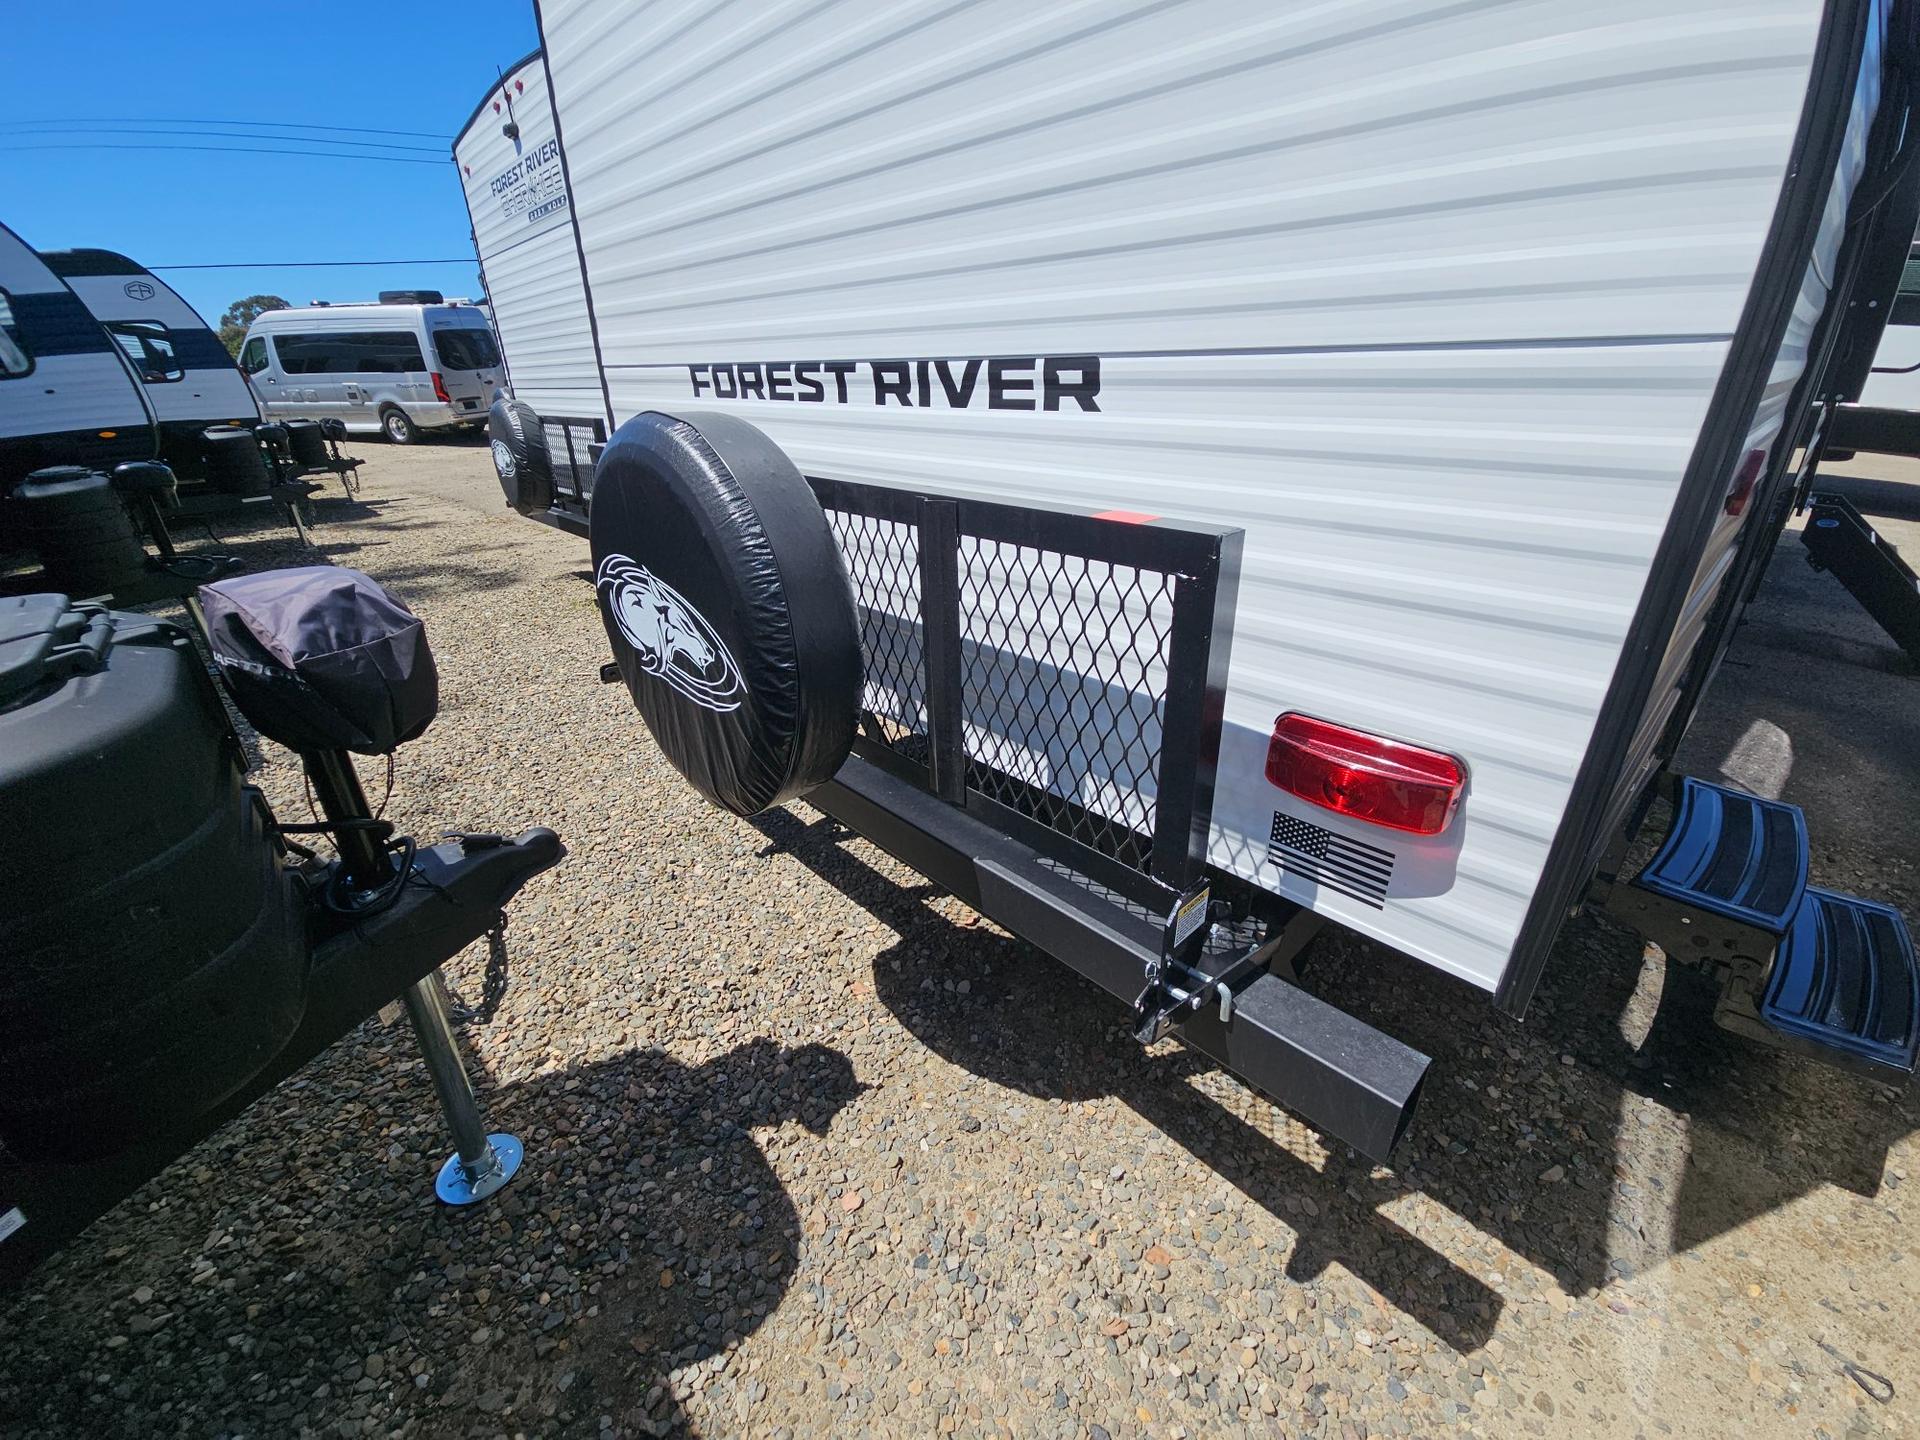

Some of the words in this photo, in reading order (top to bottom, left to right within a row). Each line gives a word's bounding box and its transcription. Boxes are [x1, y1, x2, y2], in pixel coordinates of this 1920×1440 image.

[490, 161, 523, 197] FOREST
[525, 139, 558, 174] RIVER
[688, 361, 856, 403] FOREST
[869, 355, 1101, 412] RIVER
